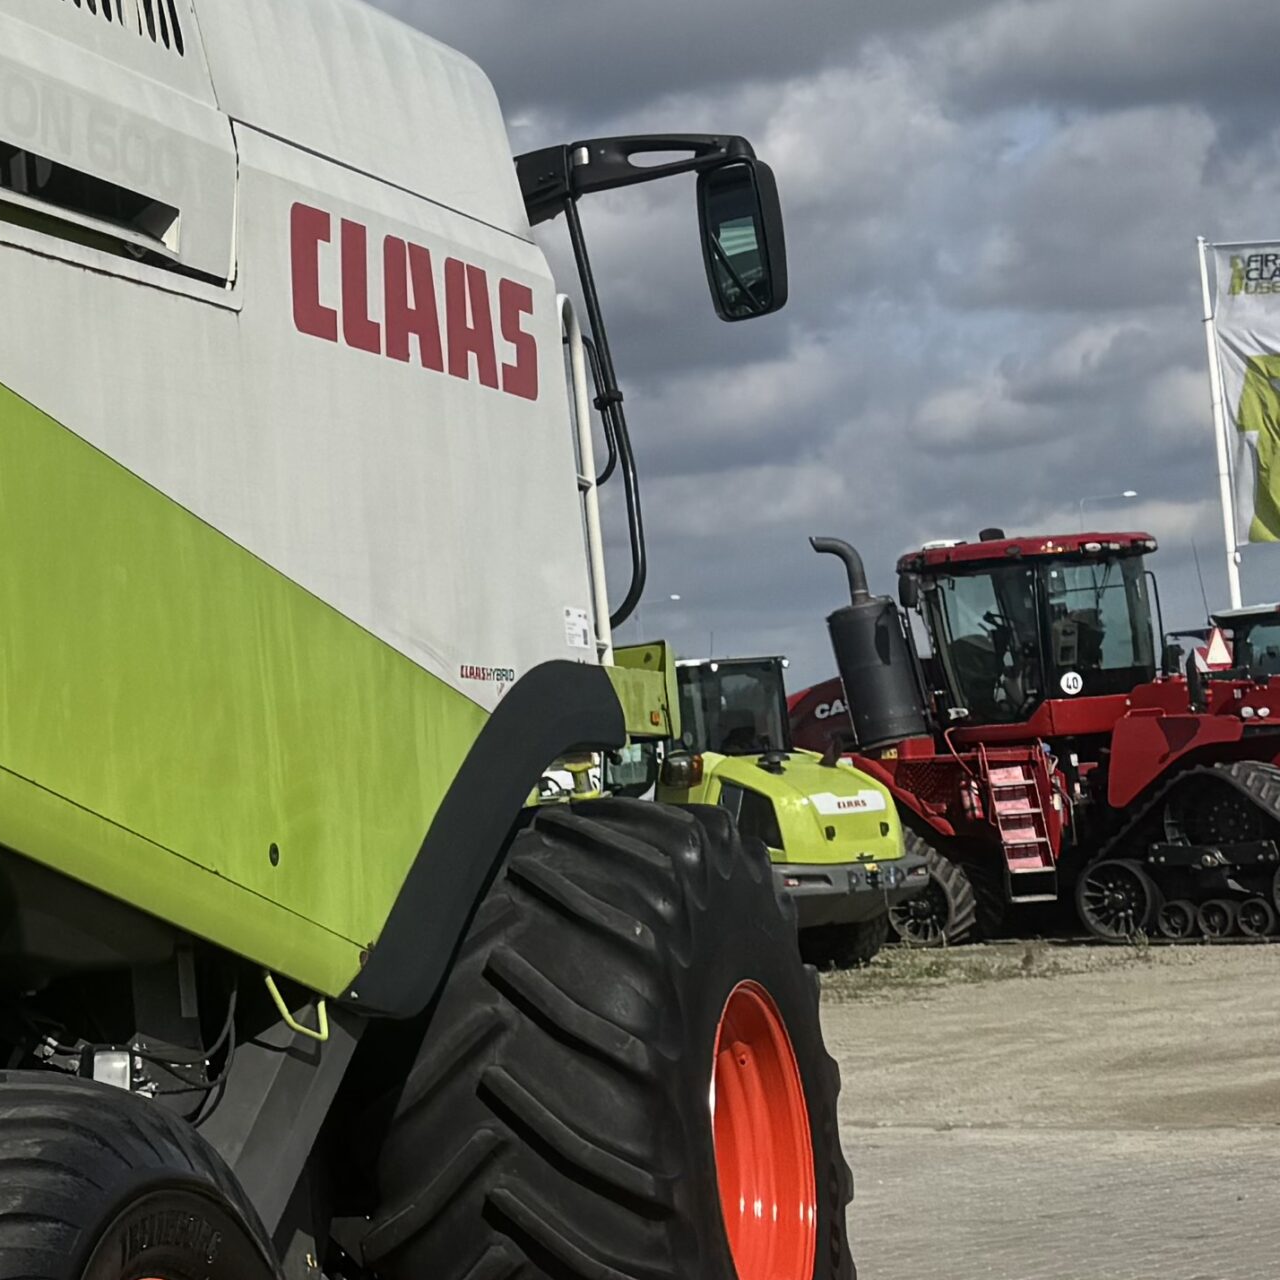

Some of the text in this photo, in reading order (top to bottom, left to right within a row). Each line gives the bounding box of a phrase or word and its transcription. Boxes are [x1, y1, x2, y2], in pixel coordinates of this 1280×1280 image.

[1246, 253, 1280, 268] FIR
[290, 201, 538, 401] CLAAS
[1066, 676, 1079, 690] 40
[814, 699, 848, 719] CA
[837, 799, 867, 809] CLAAS
